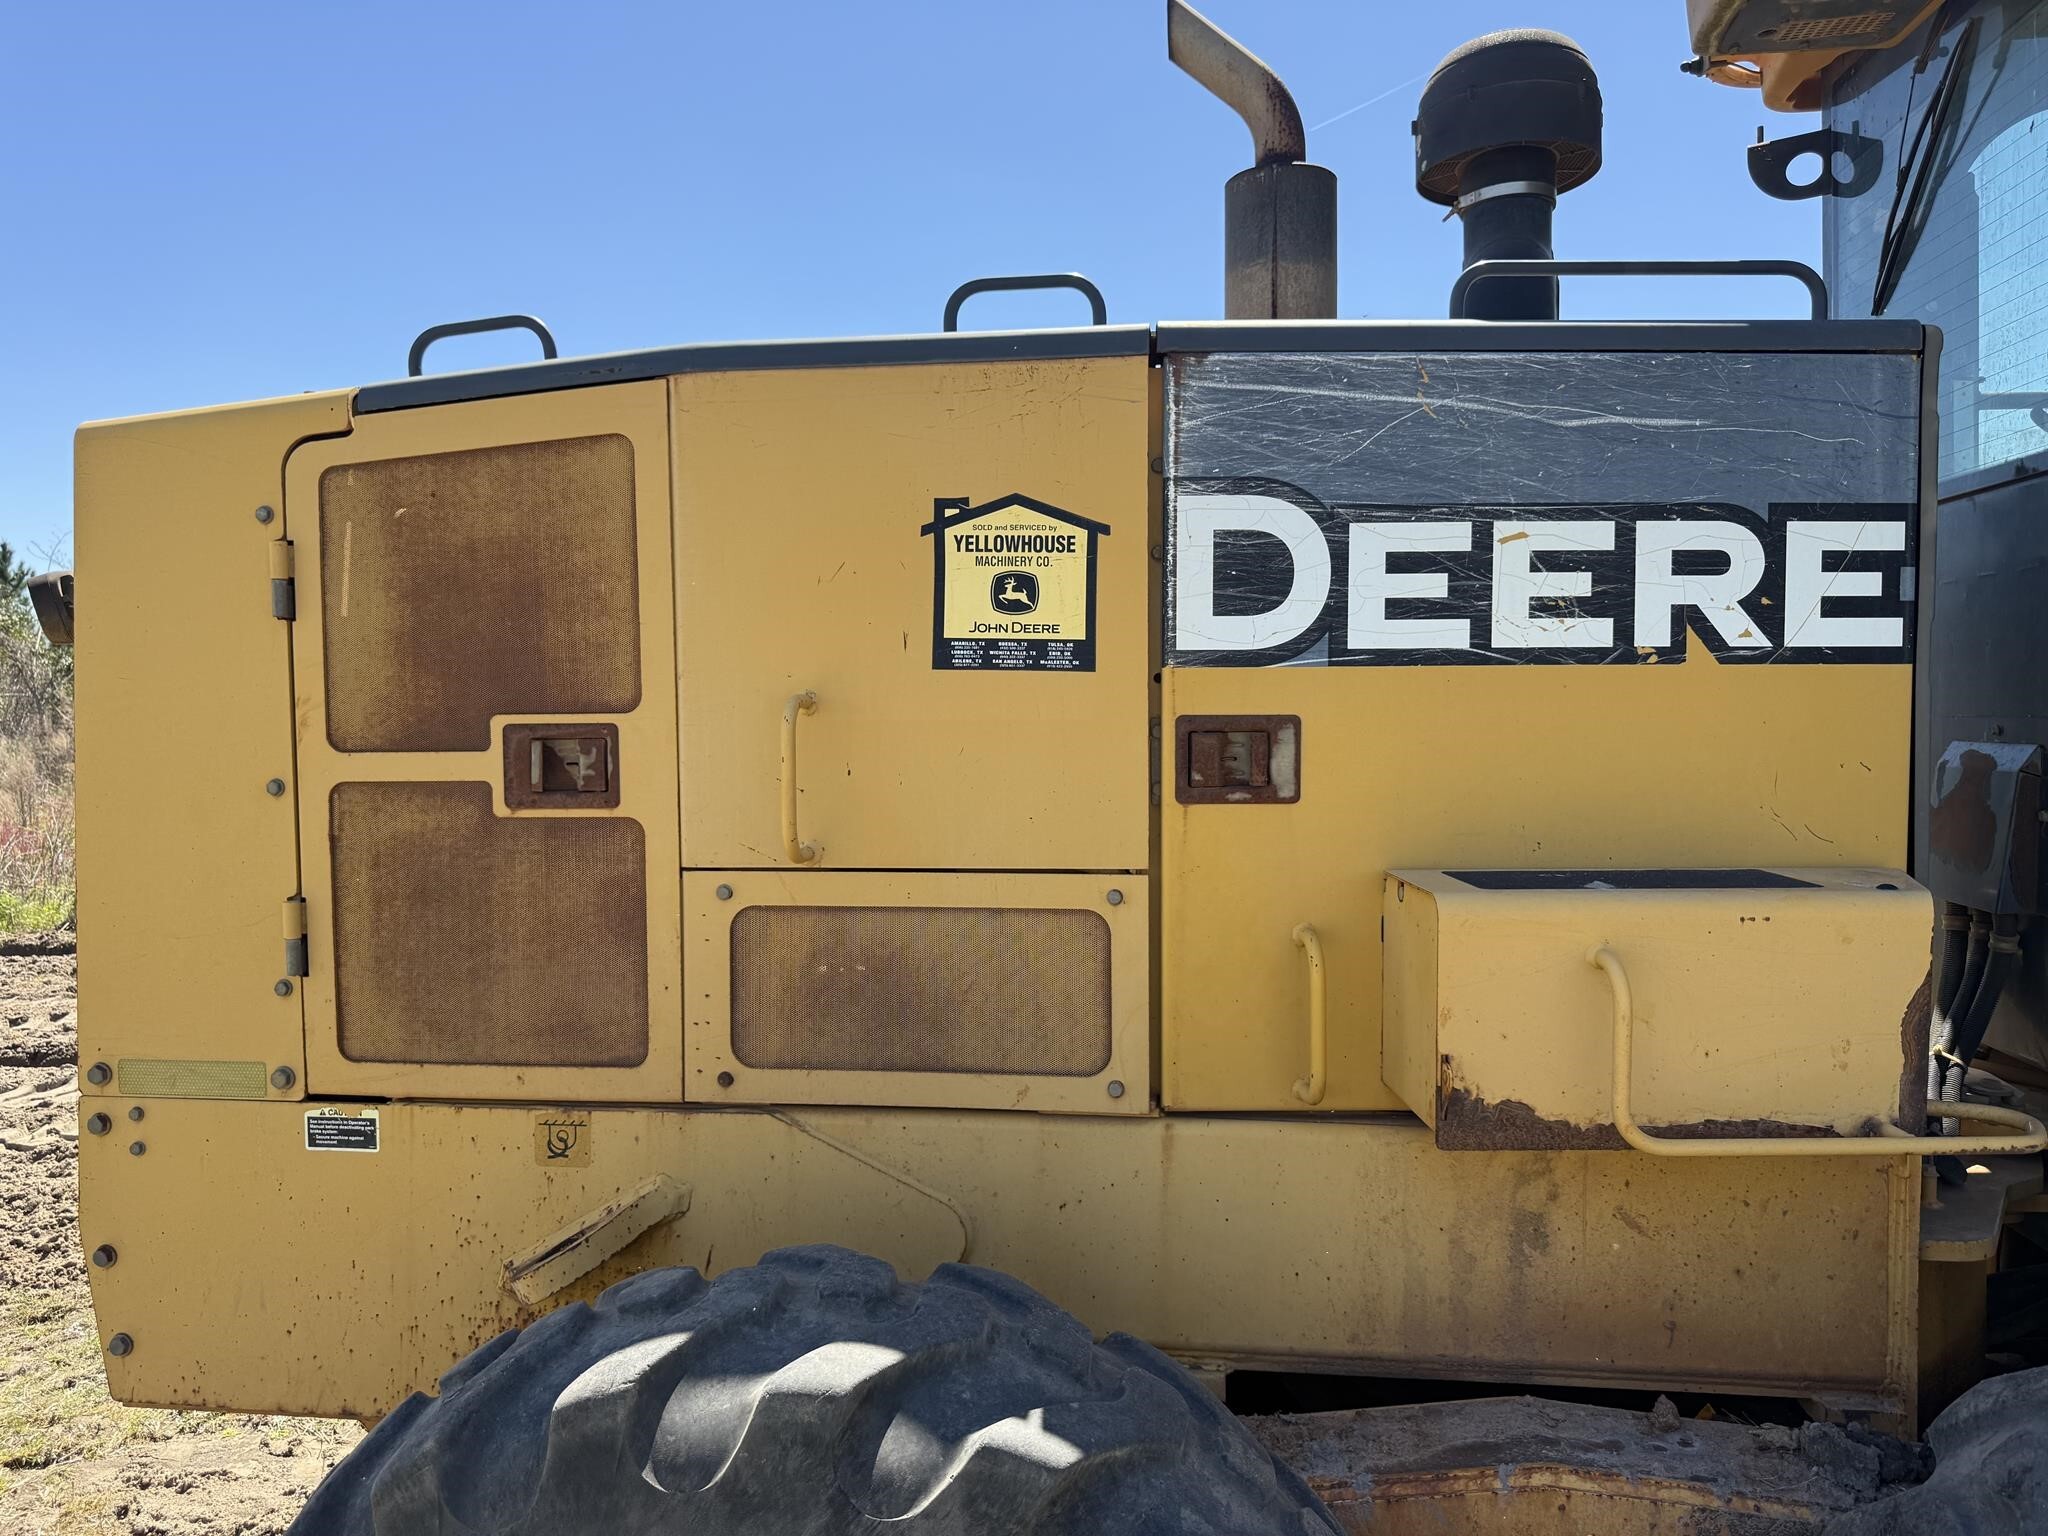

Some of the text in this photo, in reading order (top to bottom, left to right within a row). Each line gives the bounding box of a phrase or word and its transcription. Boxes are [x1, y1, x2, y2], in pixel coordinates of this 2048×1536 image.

[1048, 524, 1058, 532] by
[953, 534, 1076, 553] YELLOWHOUSE
[975, 556, 1053, 567] MACHINERY CO.
[1176, 494, 1906, 651] DEERE
[968, 621, 1061, 634] JOHN DEERE
